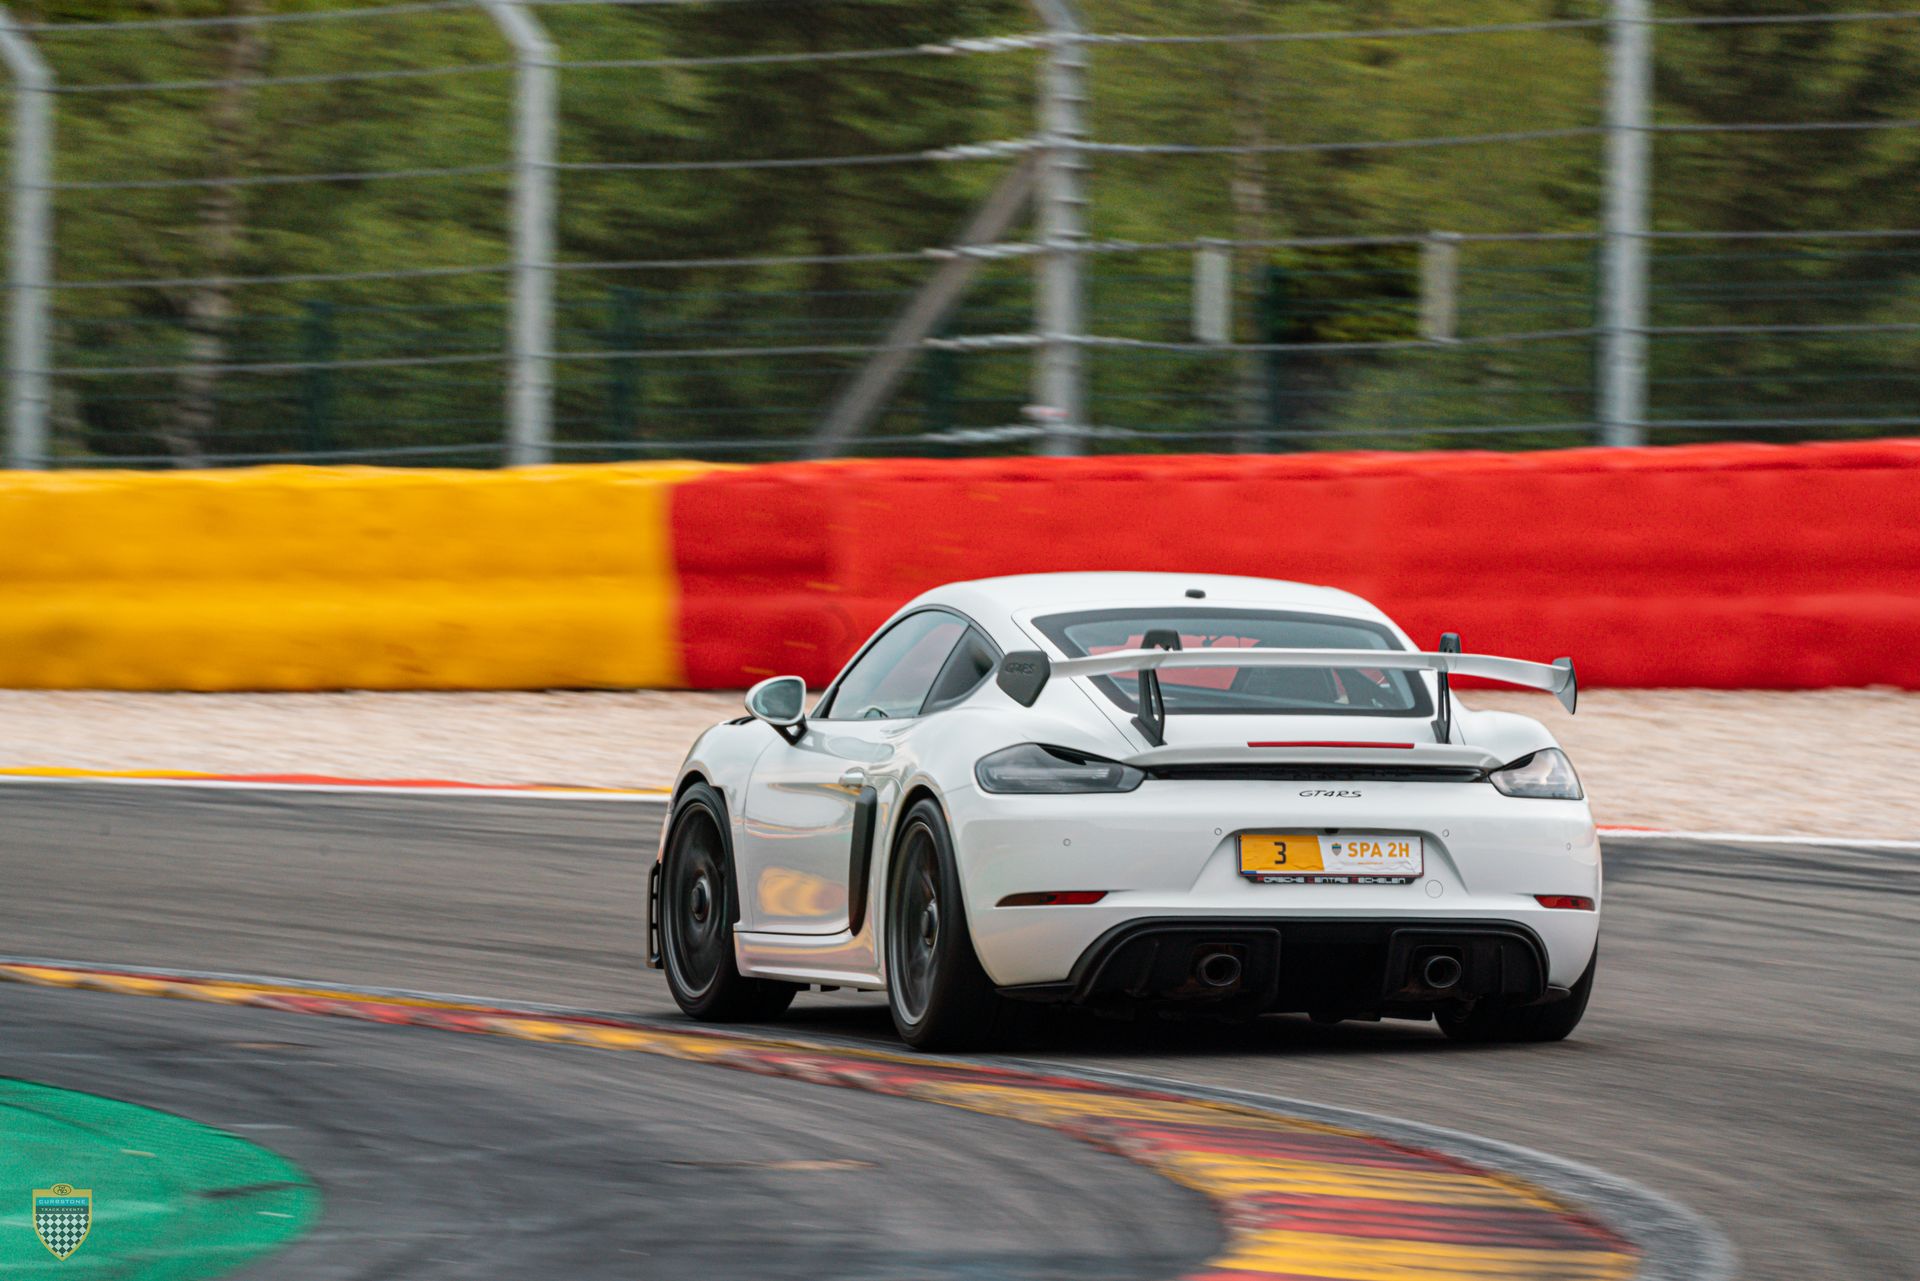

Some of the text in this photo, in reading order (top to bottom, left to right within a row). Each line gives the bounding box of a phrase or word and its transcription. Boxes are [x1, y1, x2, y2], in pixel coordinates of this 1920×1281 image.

[1299, 789, 1362, 798] GT4RS
[1273, 841, 1287, 865] 3
[1347, 842, 1410, 858] SPA 2H
